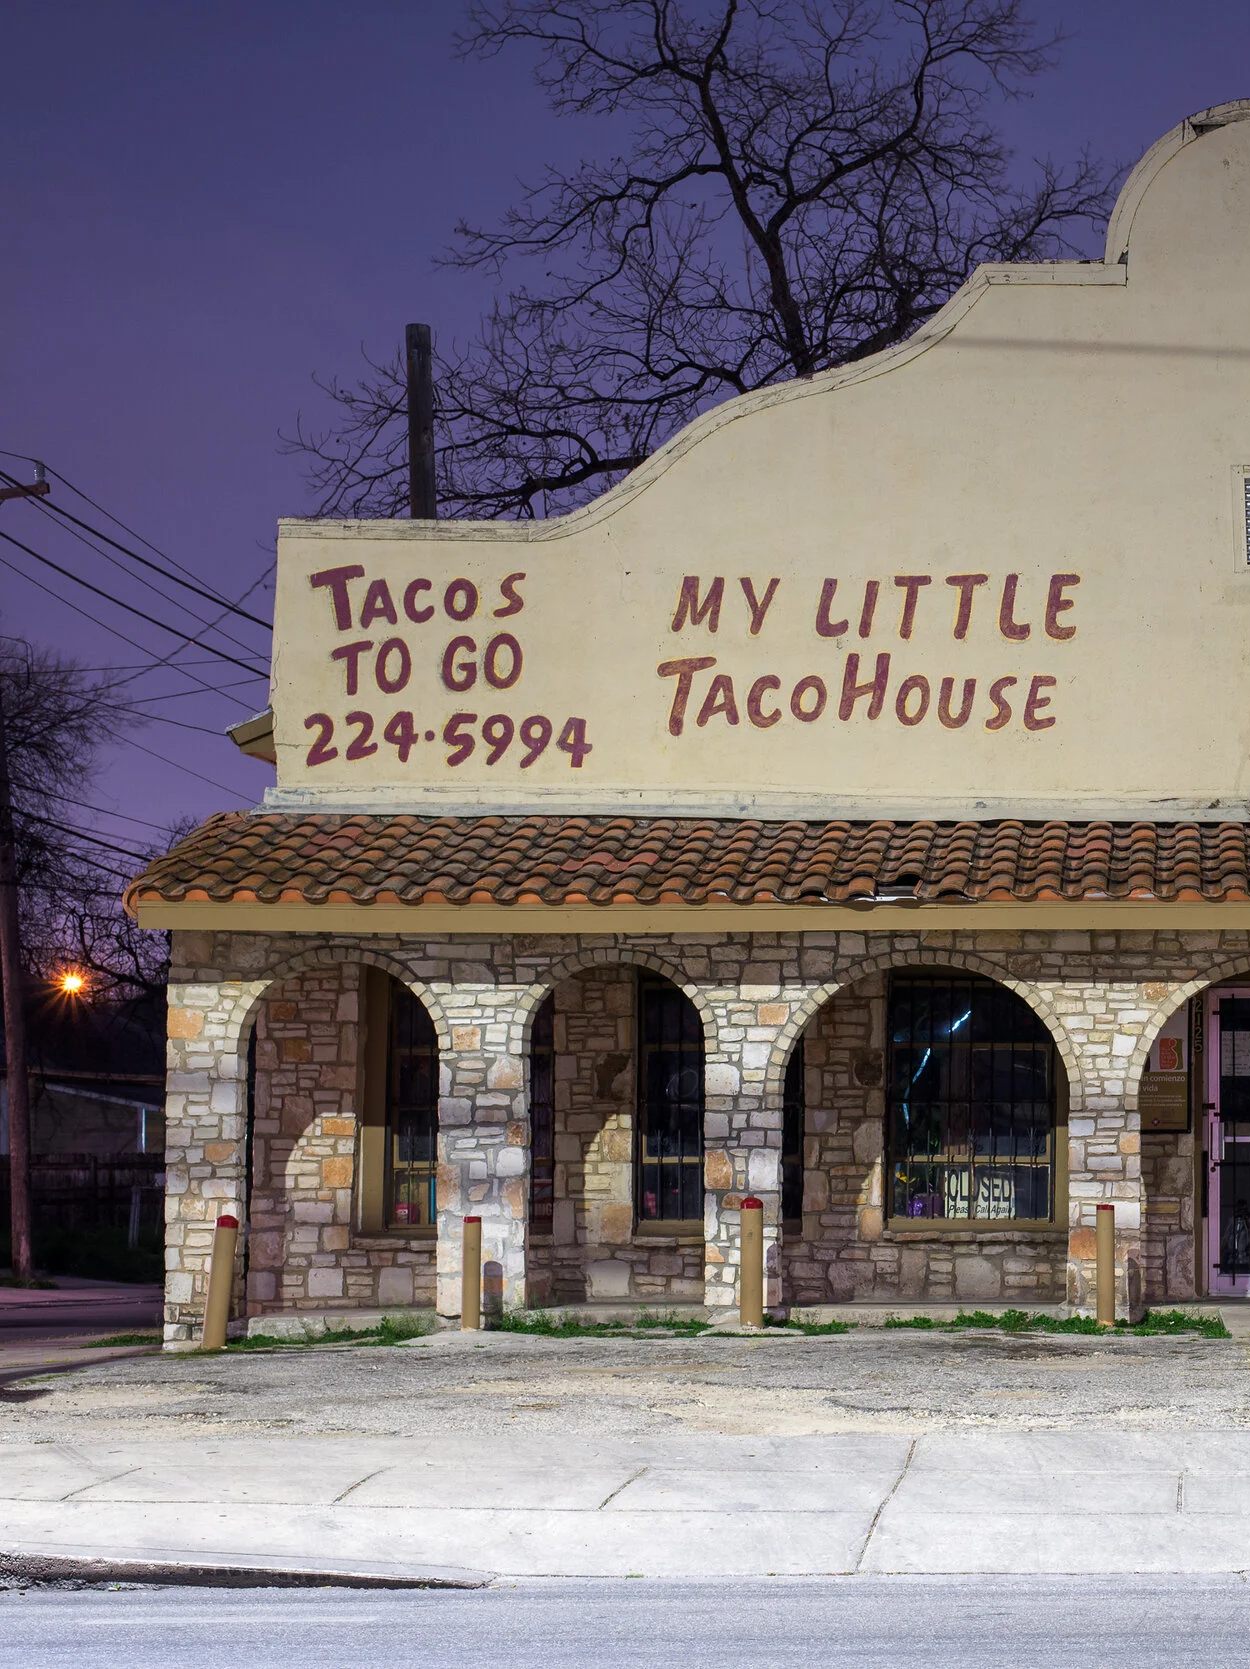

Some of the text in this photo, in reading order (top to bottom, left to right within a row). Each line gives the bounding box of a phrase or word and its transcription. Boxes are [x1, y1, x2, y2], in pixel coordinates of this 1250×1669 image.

[311, 565, 527, 632] TACOS
[670, 573, 1081, 641] MY LITTLE
[331, 633, 524, 696] TO GO
[1143, 1084, 1159, 1092] vida
[1150, 1074, 1186, 1082] comienzo
